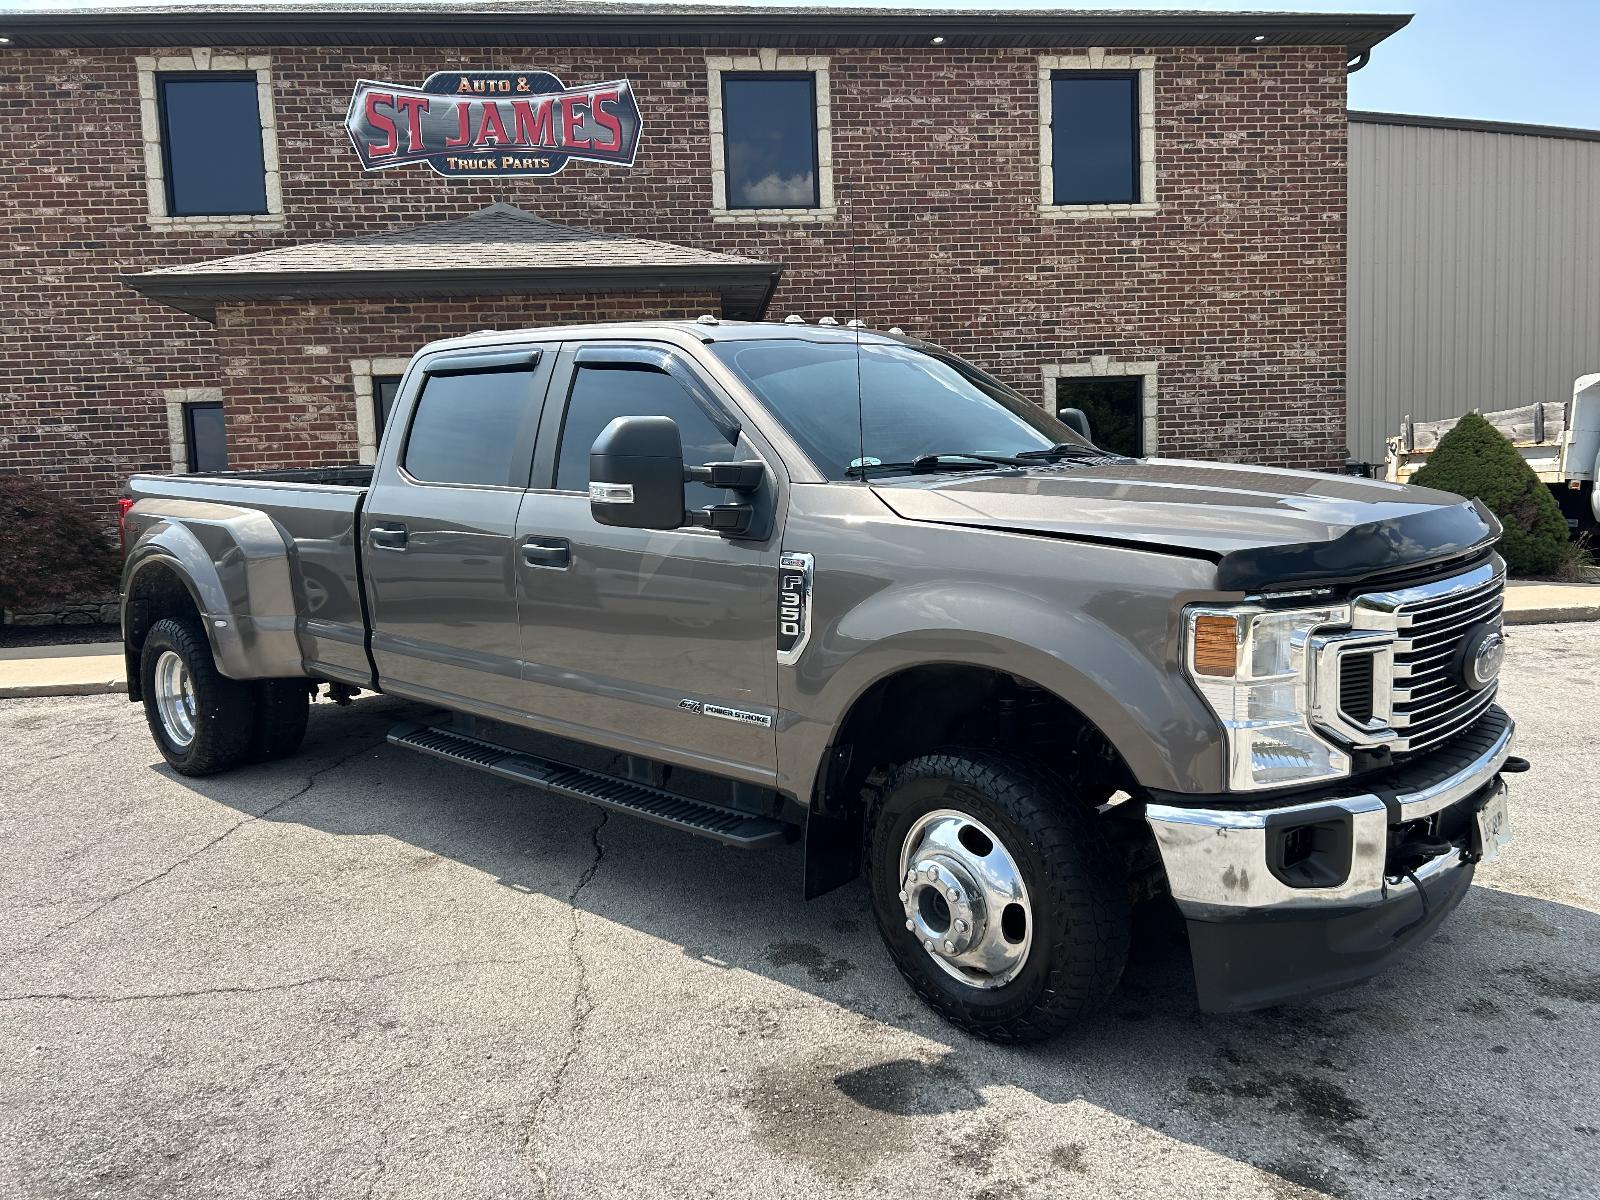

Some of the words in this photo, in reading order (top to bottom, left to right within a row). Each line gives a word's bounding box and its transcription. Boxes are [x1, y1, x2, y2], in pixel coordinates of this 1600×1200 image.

[457, 77, 510, 93] AUTO
[517, 77, 531, 93] &
[365, 91, 430, 158] ST
[445, 90, 624, 153] JAMES
[447, 156, 498, 170] TRUCK
[502, 155, 550, 169] PARTS
[705, 705, 733, 717] POWER
[735, 711, 769, 724] STROKE
